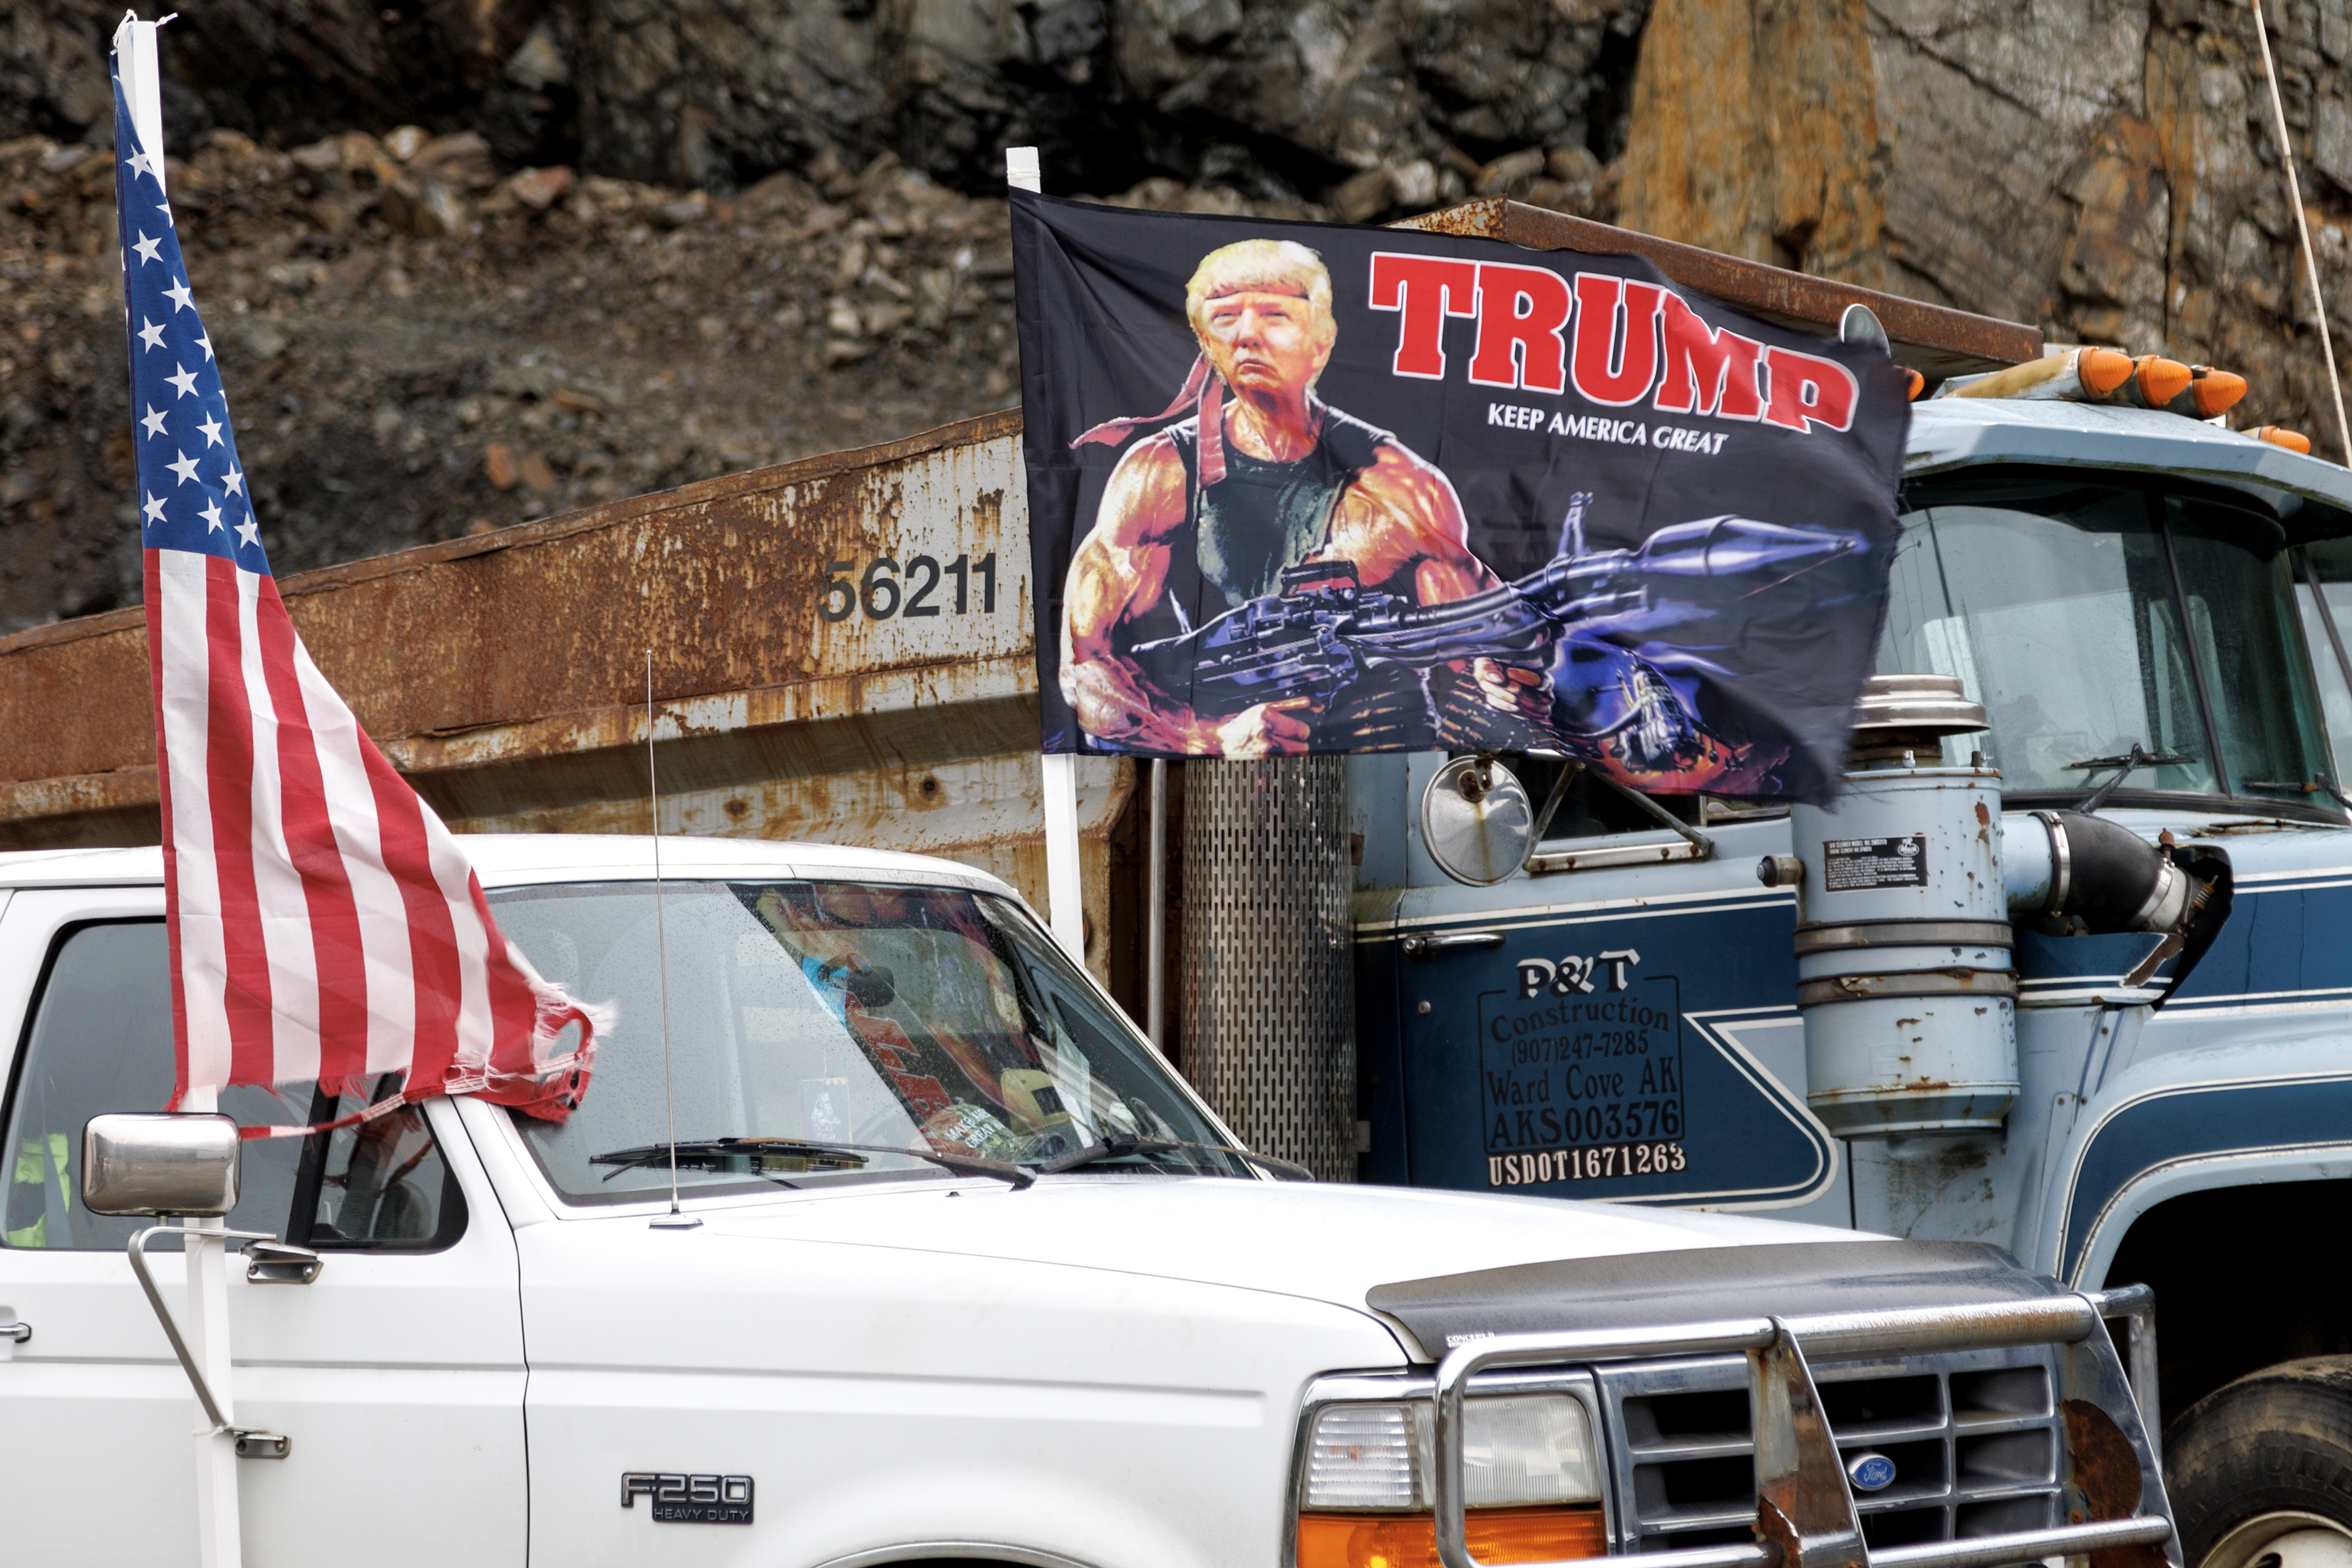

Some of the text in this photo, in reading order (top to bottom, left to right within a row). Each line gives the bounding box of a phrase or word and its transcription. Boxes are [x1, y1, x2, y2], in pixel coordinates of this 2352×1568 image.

[1369, 252, 1860, 434] TRUMP
[1487, 403, 1730, 455] KEEP AMERICA GREAT
[817, 552, 996, 623] 56211
[1515, 949, 1641, 1001] P&T
[1490, 998, 1670, 1043] Construction
[1512, 1029, 1649, 1068] (907)247-7285
[1487, 1056, 1678, 1107] Ward Cove AK
[944, 1116, 976, 1142] MAKE
[965, 1123, 996, 1149] GREAT
[1489, 1099, 1680, 1148] AKS003576
[1488, 1143, 1686, 1187] USDOT1671263
[1864, 1462, 1887, 1482] Ford
[654, 1507, 749, 1522] HEAVY DUTY
